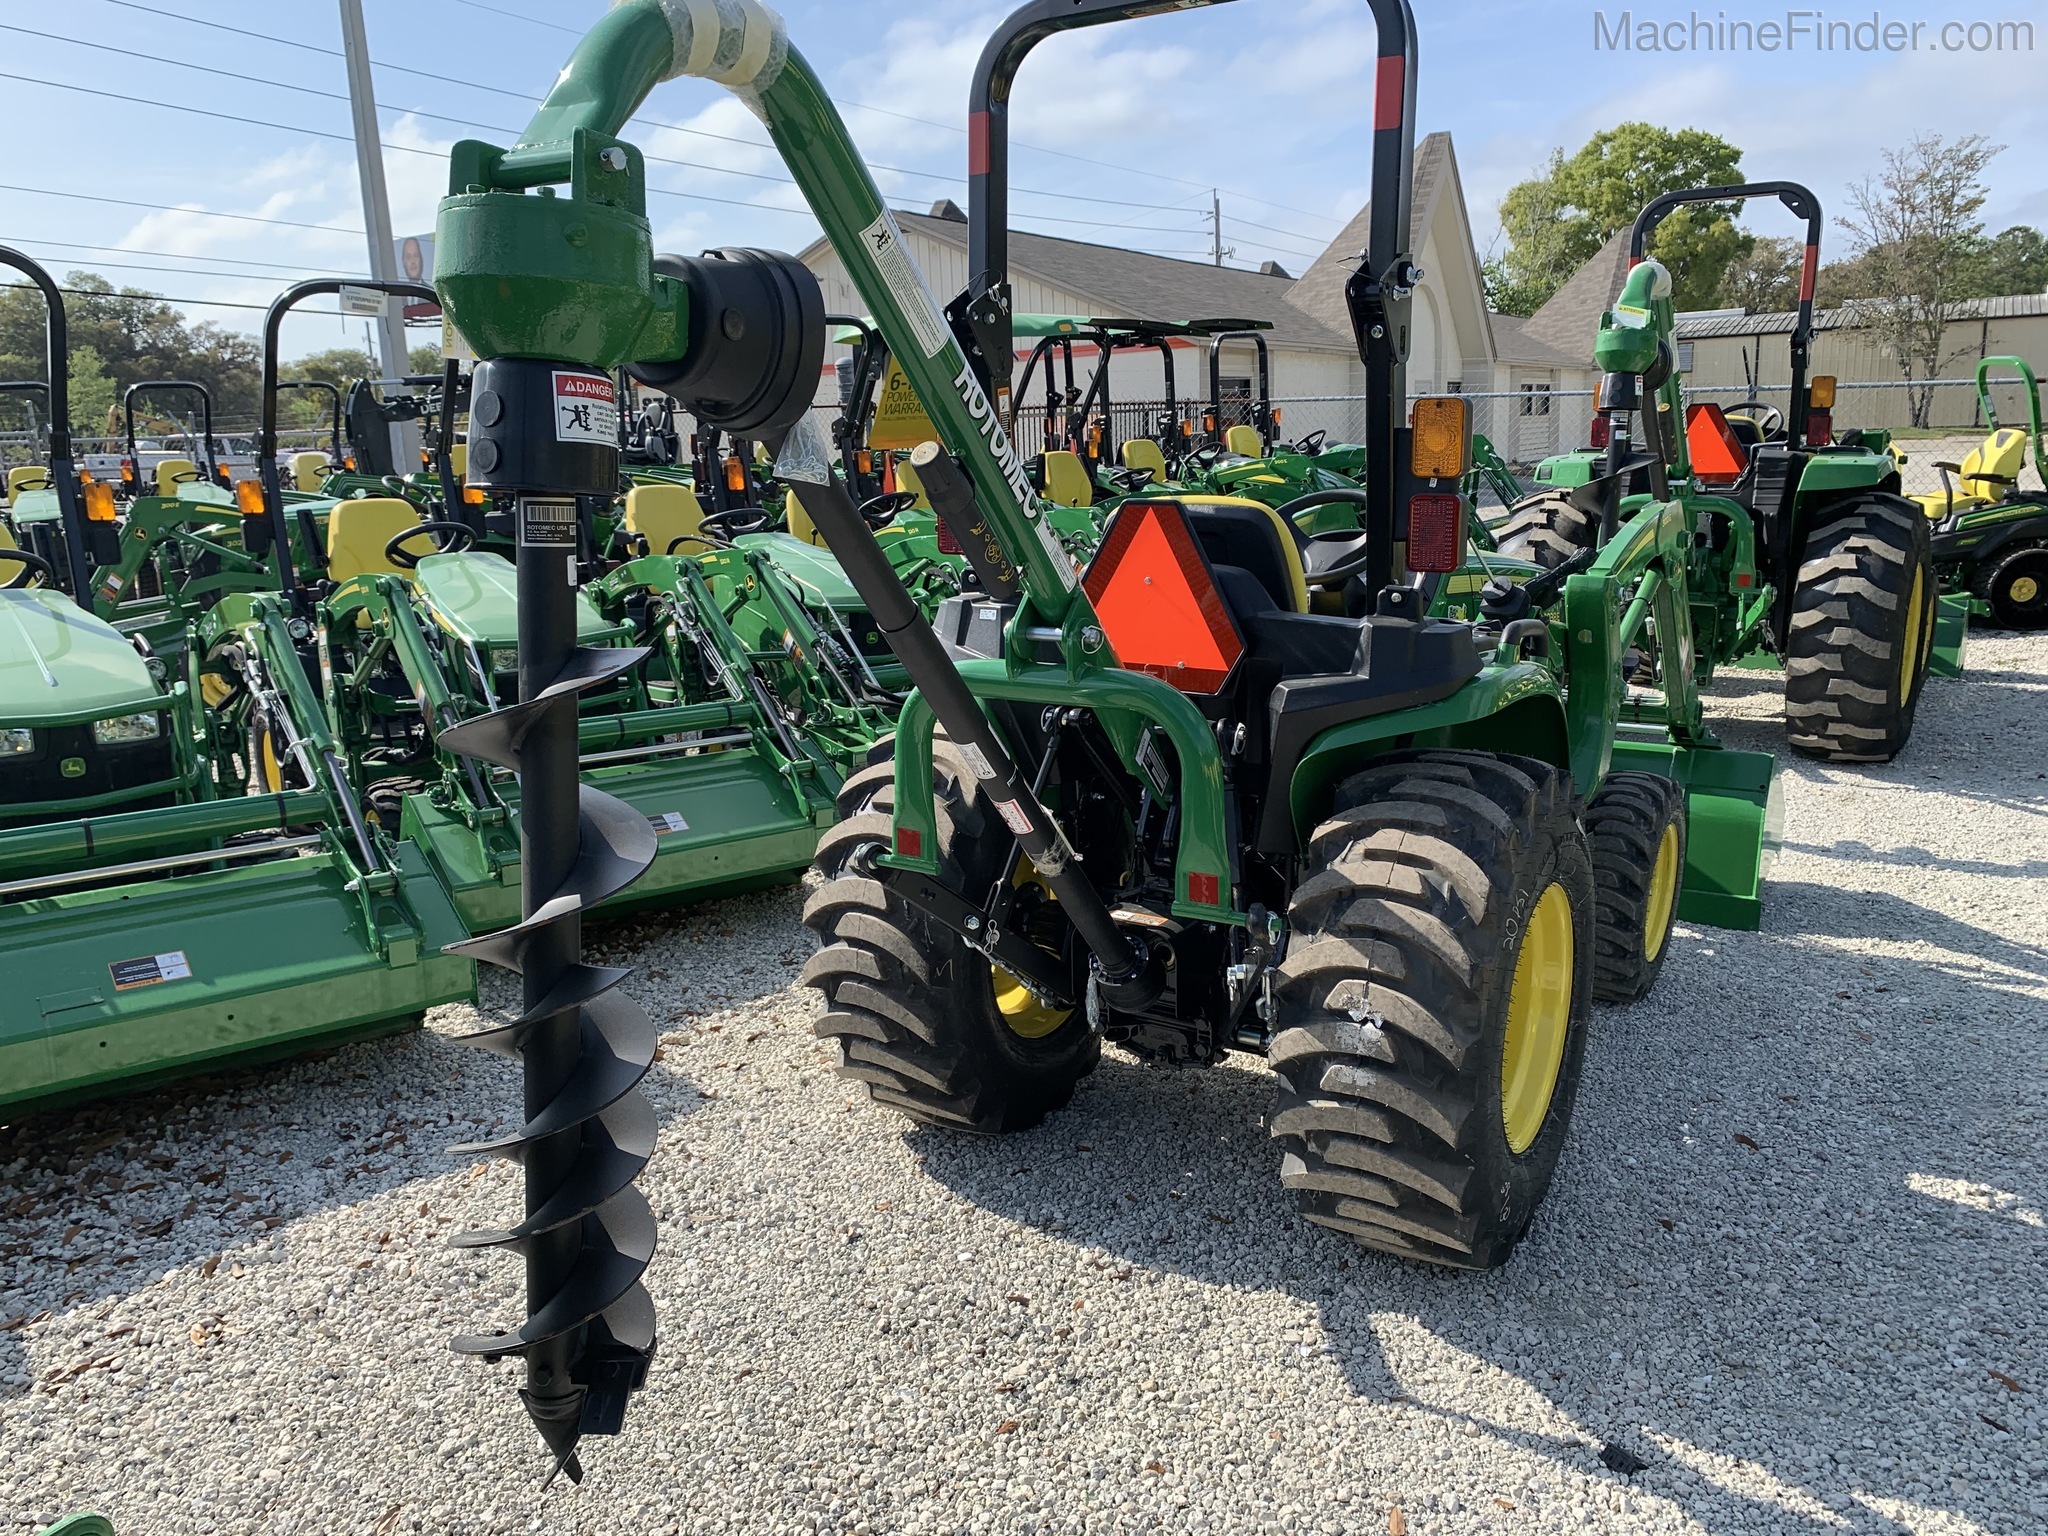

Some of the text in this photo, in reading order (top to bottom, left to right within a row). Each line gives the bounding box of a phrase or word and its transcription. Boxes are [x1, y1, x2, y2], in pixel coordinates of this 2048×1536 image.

[576, 381, 613, 398] DANGER
[420, 402, 442, 415] DEE
[954, 362, 1039, 519] ROTOMEC
